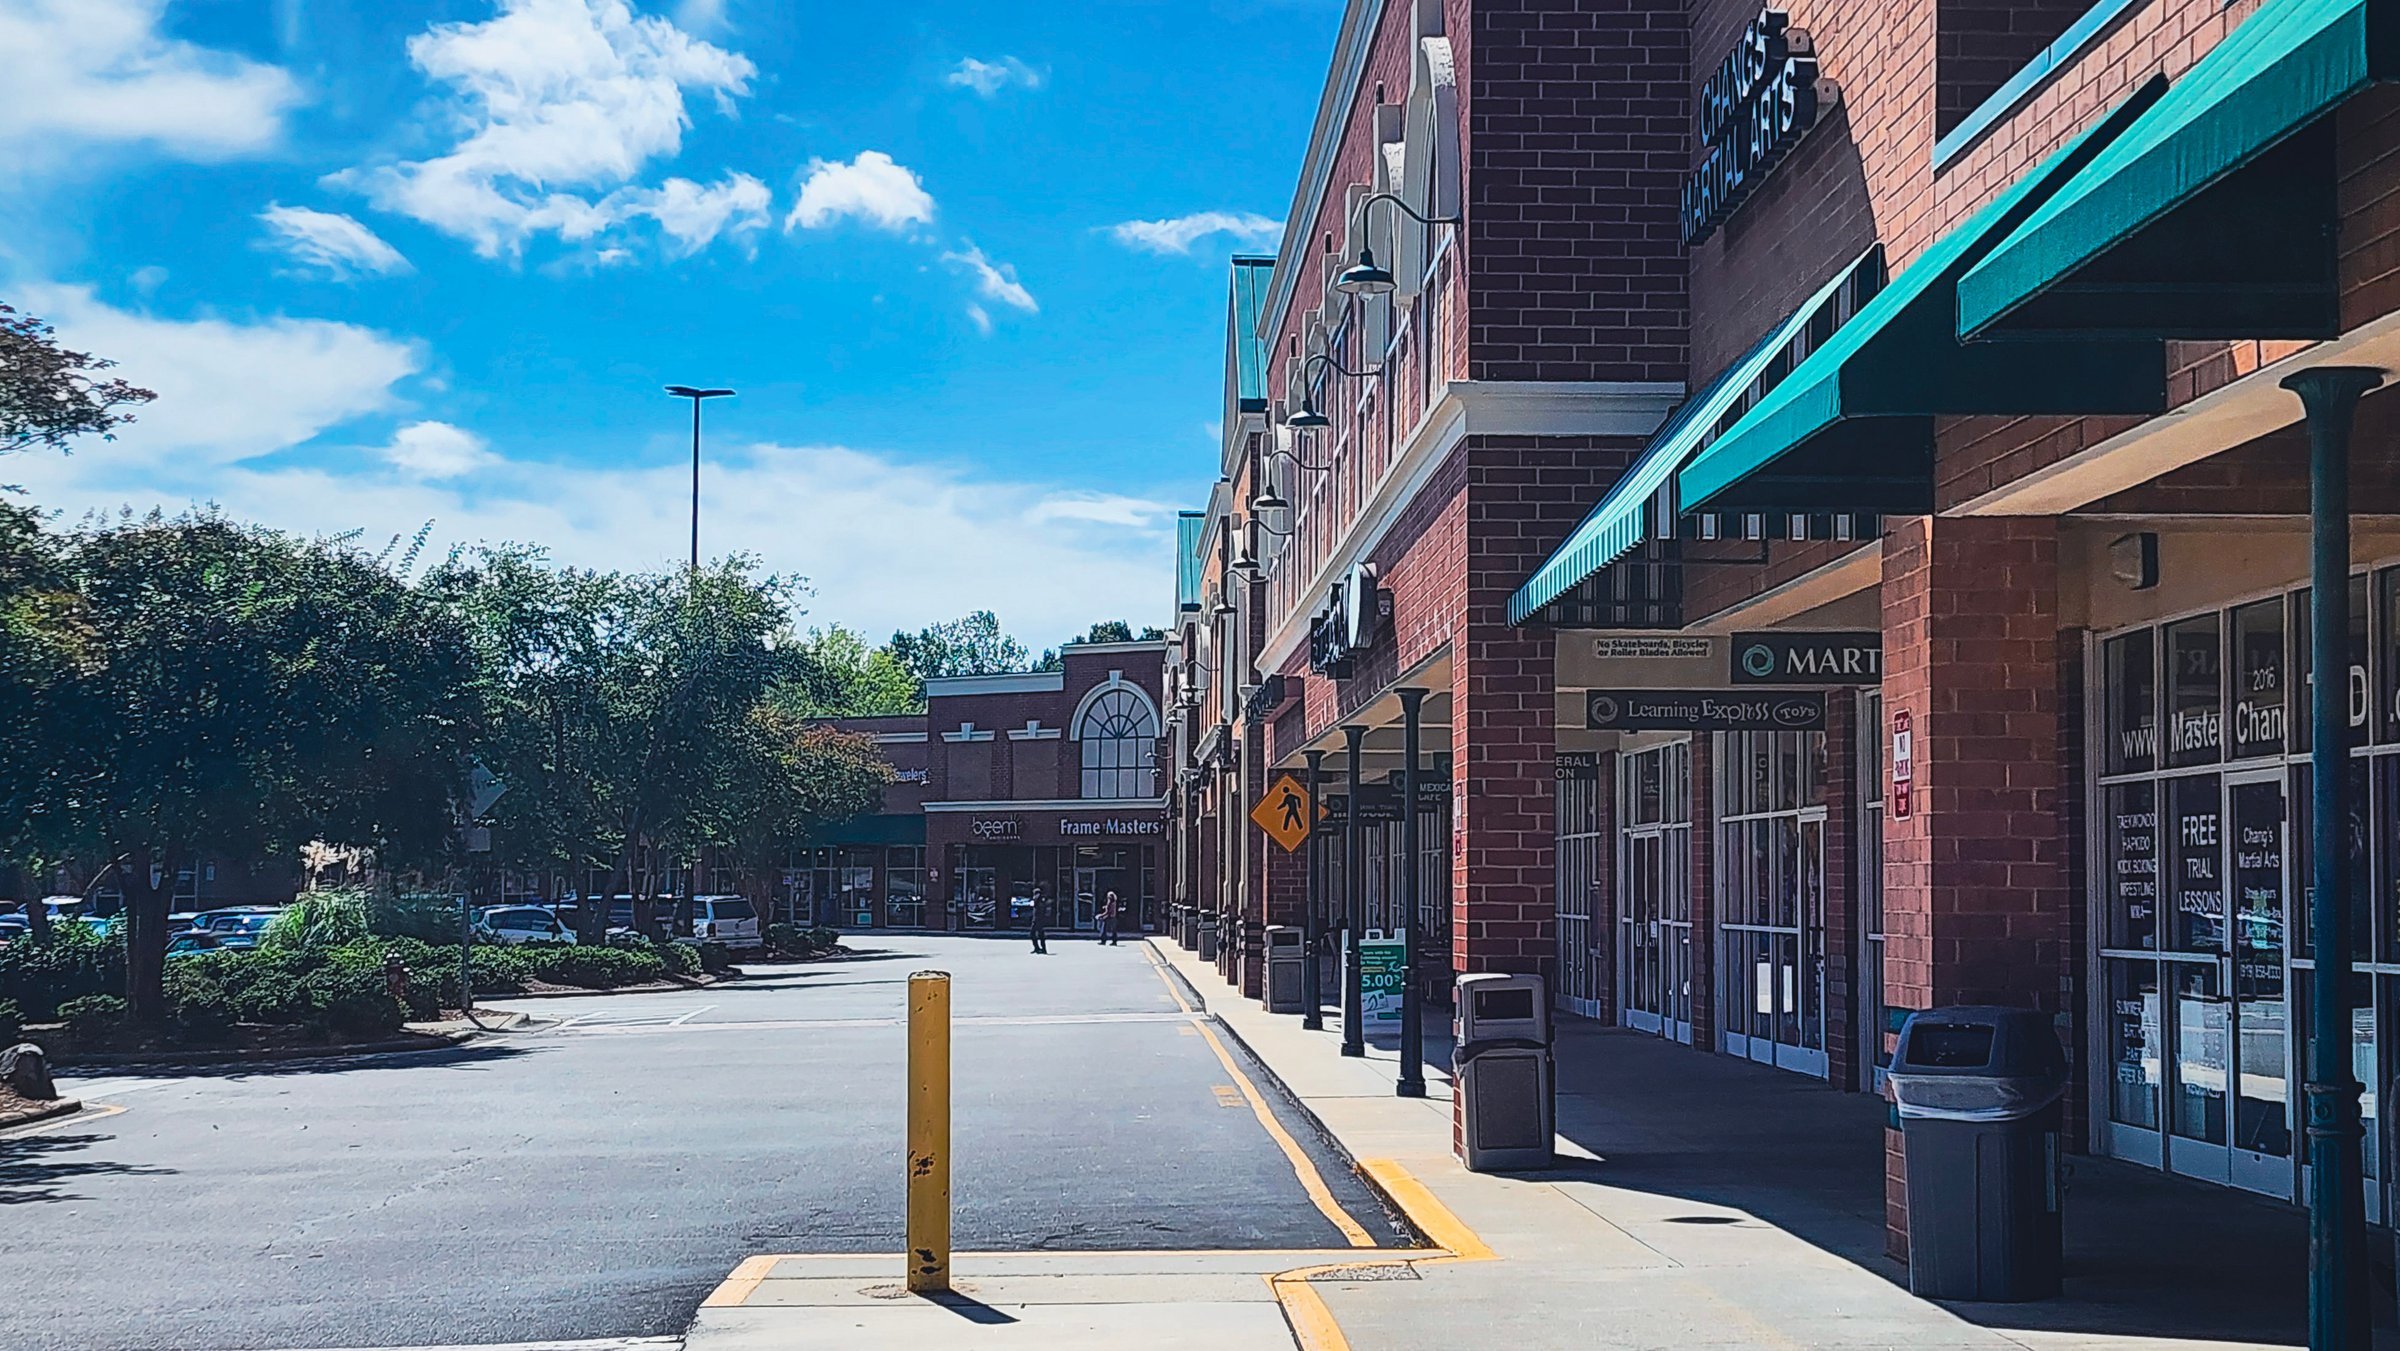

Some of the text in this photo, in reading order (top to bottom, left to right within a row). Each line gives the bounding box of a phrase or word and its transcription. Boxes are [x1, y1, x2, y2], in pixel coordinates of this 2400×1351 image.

[1681, 59, 1797, 246] MARTIAL ARTS
[1597, 640, 1610, 648] No
[1673, 640, 1709, 649] Bicycles
[1786, 648, 1882, 674] MART
[1628, 700, 1699, 722] Learning
[1702, 698, 1769, 724] Express
[1555, 756, 1591, 767] ERAL
[1420, 783, 1451, 792] MEXICA
[972, 816, 1017, 837] beem
[1060, 818, 1159, 835] Frame Masters
[2182, 814, 2217, 847] FREE
[2186, 857, 2214, 878] TRIAL
[2238, 851, 2280, 868] Martial Arts
[2179, 891, 2222, 913] LESSONS
